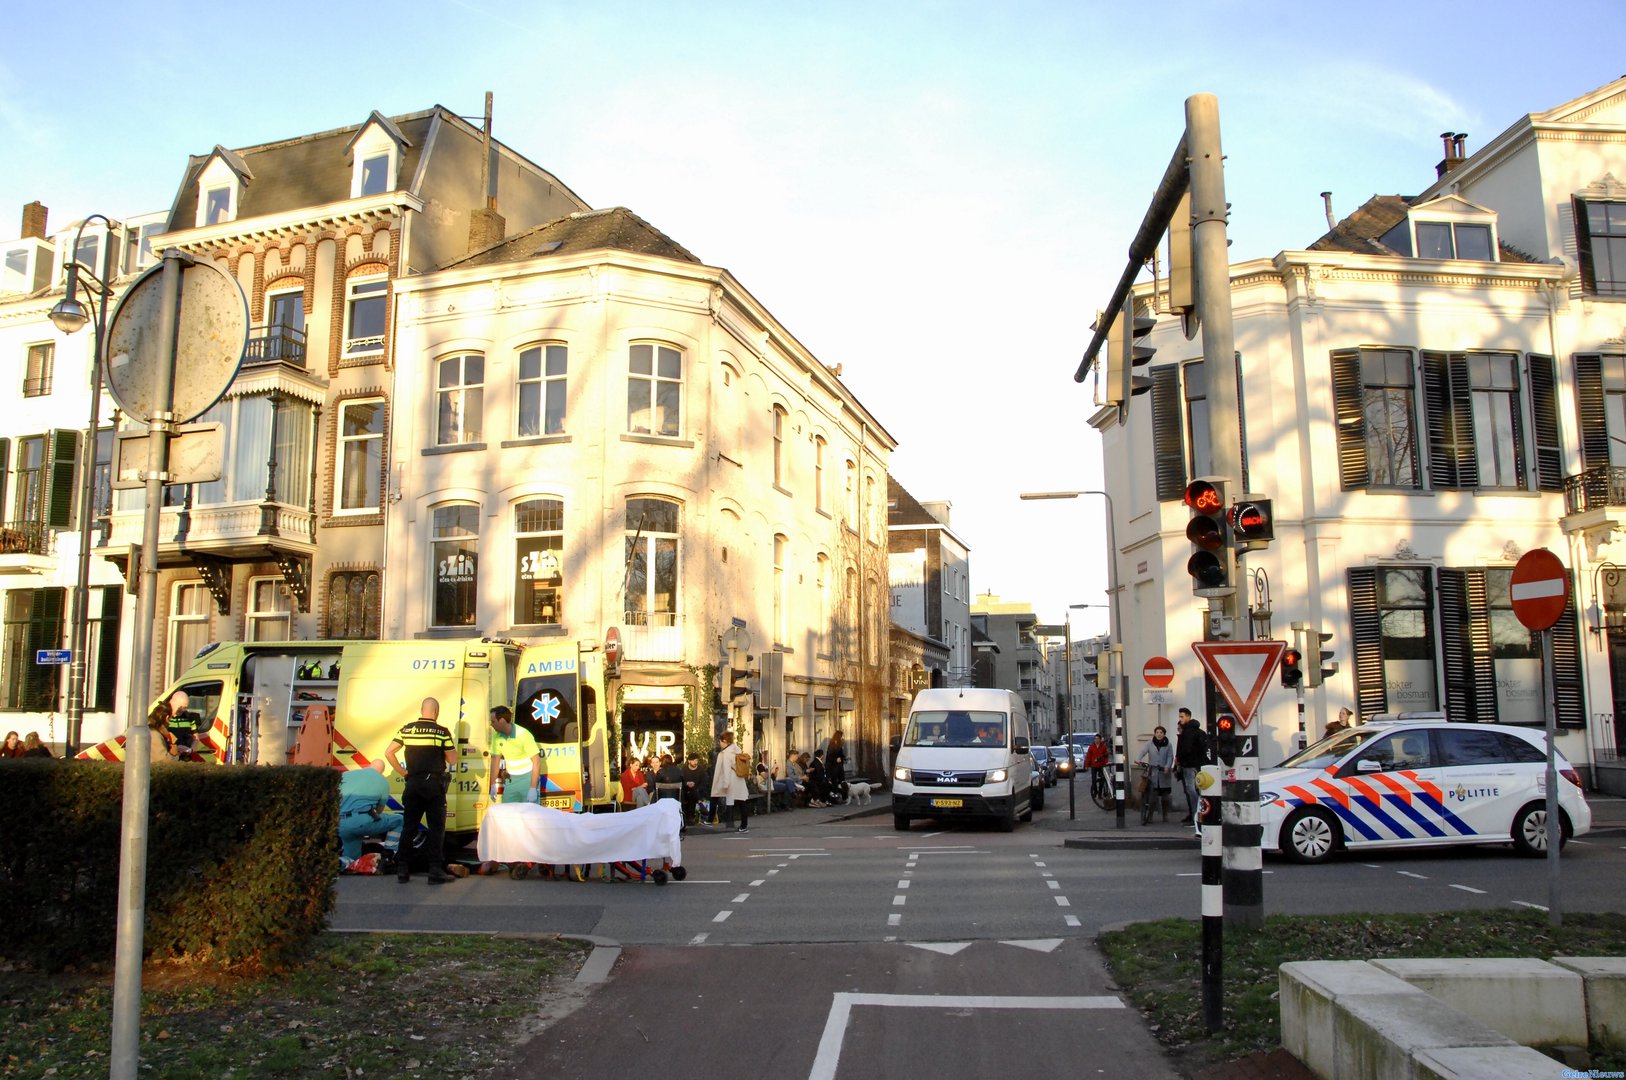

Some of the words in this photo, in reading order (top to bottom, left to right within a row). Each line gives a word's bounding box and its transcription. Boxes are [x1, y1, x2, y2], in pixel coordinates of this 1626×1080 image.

[412, 659, 456, 670] 07115
[527, 659, 575, 674] AMBU
[539, 746, 576, 758] 07115
[1449, 785, 1500, 801] POLITIE
